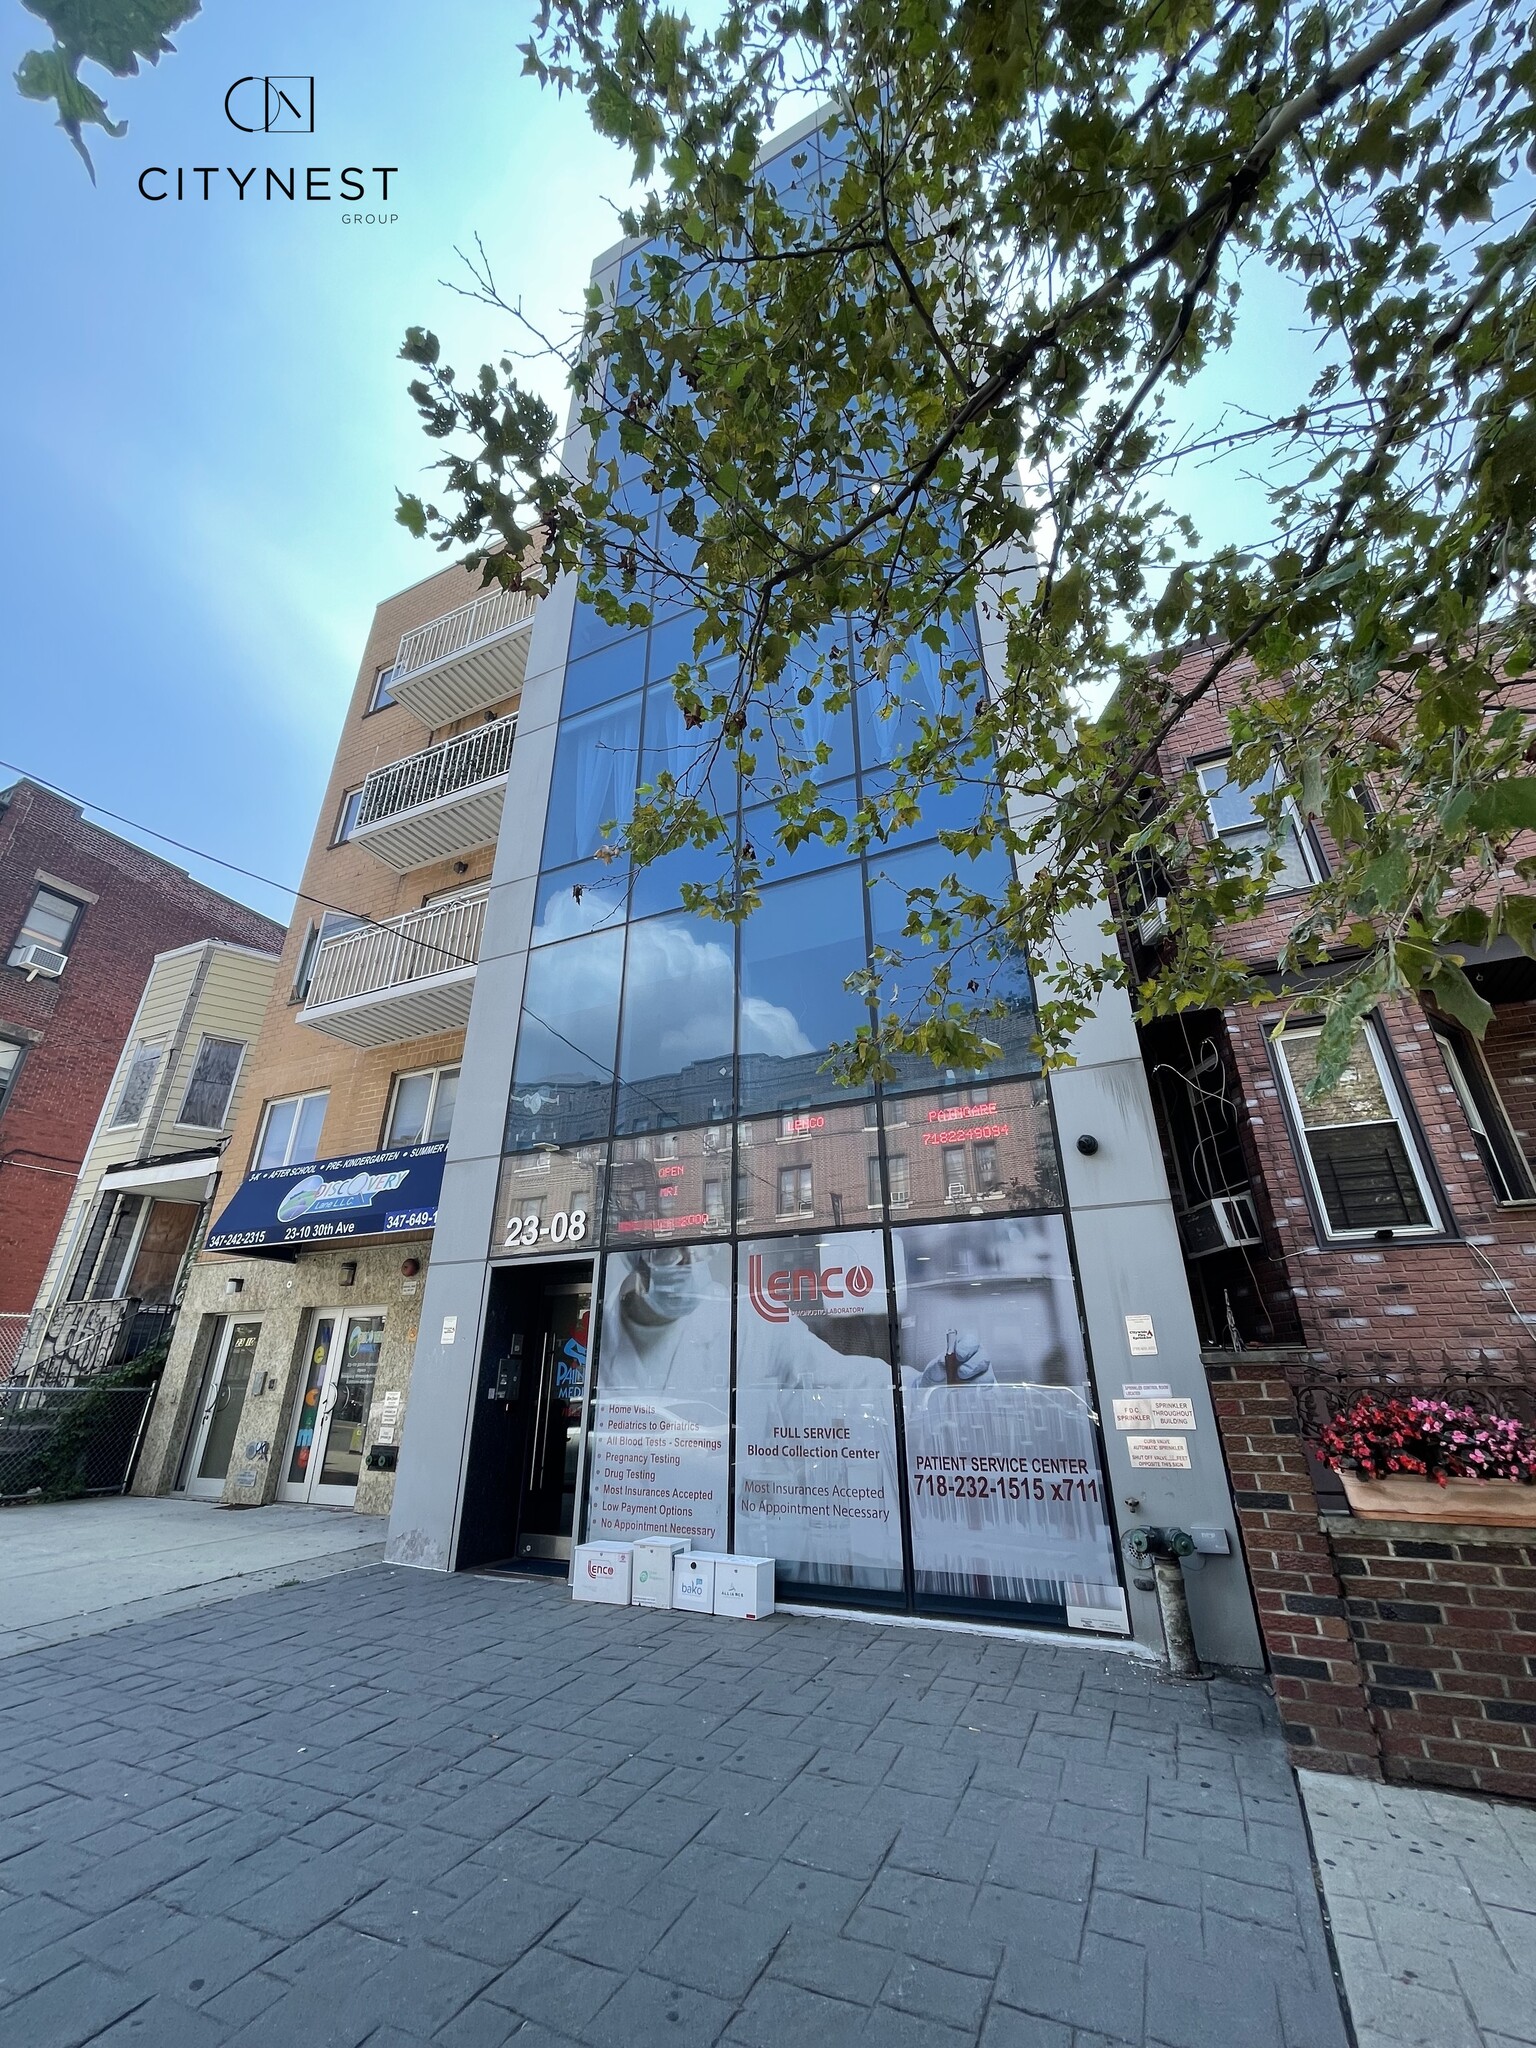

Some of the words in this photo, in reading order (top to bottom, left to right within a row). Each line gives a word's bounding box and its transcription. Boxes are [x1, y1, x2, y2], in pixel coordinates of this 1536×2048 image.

[268, 1169, 291, 1179] AFTER
[289, 1165, 318, 1177] SCHOOL
[409, 1143, 445, 1157] SUMMER
[658, 1165, 684, 1178] OPEN
[314, 1171, 407, 1198] DISCOVERY
[659, 1185, 679, 1198] MRI
[208, 1230, 266, 1248] 347-242-2315
[284, 1225, 311, 1240] 23-10
[312, 1222, 334, 1237] 30th
[335, 1221, 355, 1234] Ave
[504, 1209, 587, 1247] 23-08
[826, 1307, 865, 1315] LABORATORY
[608, 1404, 632, 1414] Home
[634, 1404, 656, 1415] Visits
[607, 1420, 647, 1431] Pediatrics
[649, 1420, 657, 1431] to
[659, 1420, 700, 1432] Geriatrics
[1116, 1414, 1151, 1422] SPRINKLER
[773, 1427, 800, 1439] FULL
[803, 1427, 850, 1440] SERVICE
[606, 1436, 618, 1446] All
[619, 1436, 643, 1447] Blood
[645, 1436, 667, 1447] Tests
[674, 1438, 722, 1451] Screenings
[605, 1452, 648, 1464] Pregnancy
[650, 1453, 681, 1466] Testing
[747, 1444, 779, 1457] Blood
[782, 1445, 838, 1459] Collection
[841, 1447, 880, 1460] Center
[916, 1455, 967, 1472] PATIENT
[971, 1457, 1029, 1473] SERVICE
[1031, 1458, 1089, 1475] CENTER
[604, 1468, 624, 1480] Drug
[626, 1468, 656, 1482] Testing
[603, 1484, 623, 1495] Most
[625, 1485, 670, 1498] Insurances
[672, 1488, 713, 1501] Accepted
[744, 1481, 770, 1494] Most
[773, 1482, 829, 1497] Insurances
[832, 1484, 885, 1501] Accepted
[914, 1474, 1045, 1501] 718-232-1515
[1050, 1478, 1099, 1503] x711
[602, 1501, 619, 1511] Low
[621, 1502, 657, 1515] Payment
[659, 1504, 693, 1517] Options
[741, 1499, 756, 1512] No
[758, 1500, 830, 1517] Appointment
[833, 1504, 890, 1522] Necessary
[601, 1518, 612, 1529] No
[614, 1519, 668, 1533] Appointment
[670, 1523, 716, 1538] Necessary
[681, 1580, 703, 1595] bako
